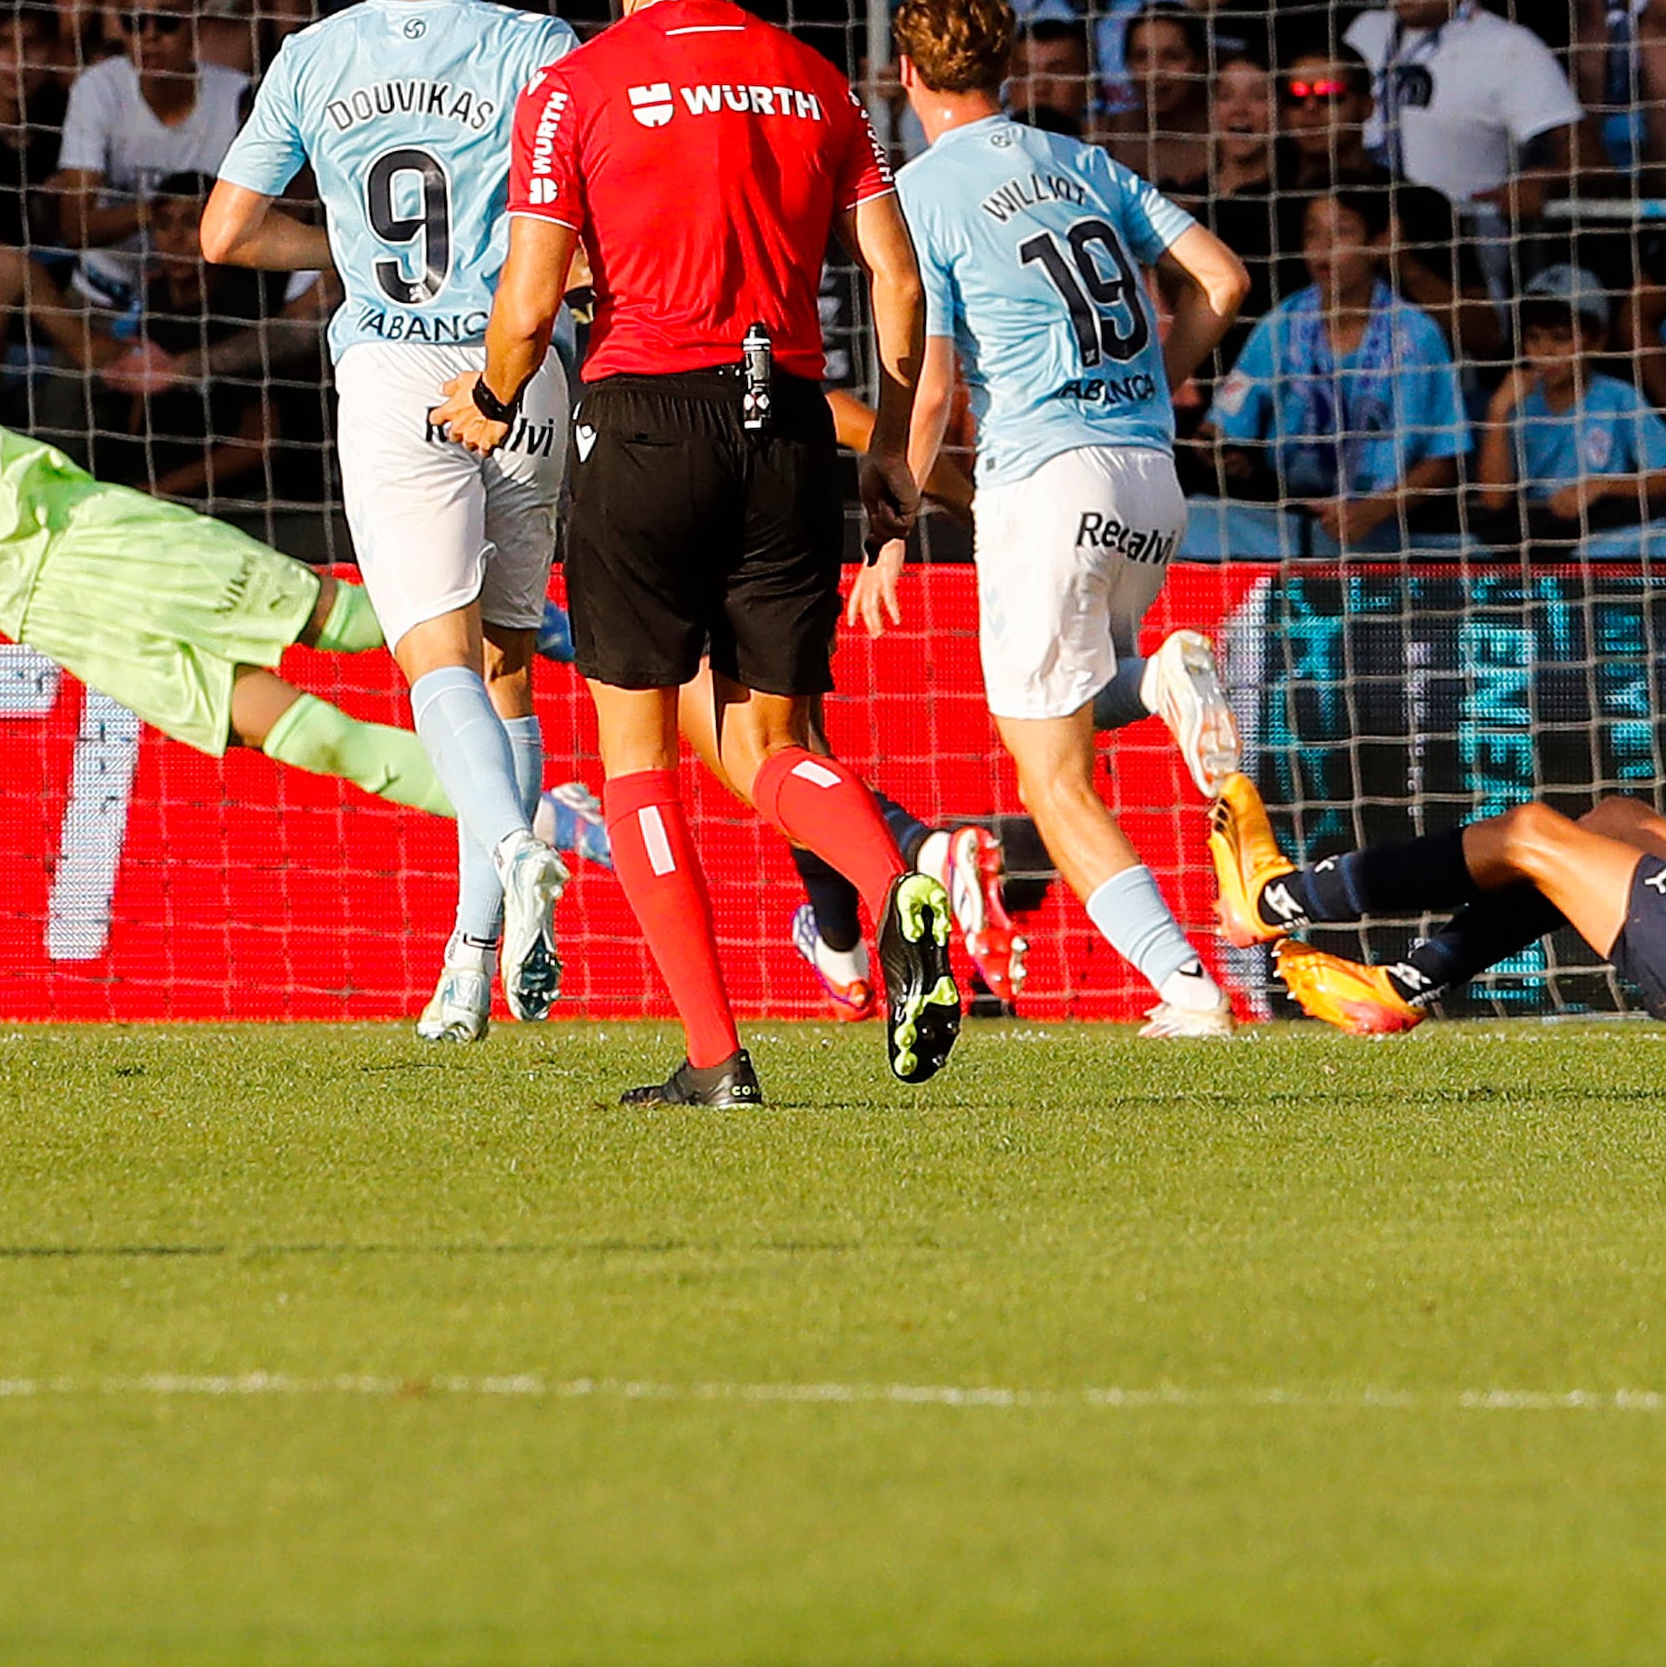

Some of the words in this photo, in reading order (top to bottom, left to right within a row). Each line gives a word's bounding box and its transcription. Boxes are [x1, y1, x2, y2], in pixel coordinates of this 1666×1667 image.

[326, 80, 494, 131] DOUVIKAS
[680, 84, 822, 121] WÜRTH
[982, 174, 1087, 222] WILLIOT
[366, 147, 450, 305] 9
[1018, 217, 1151, 368] 19
[357, 307, 488, 341] ABANC
